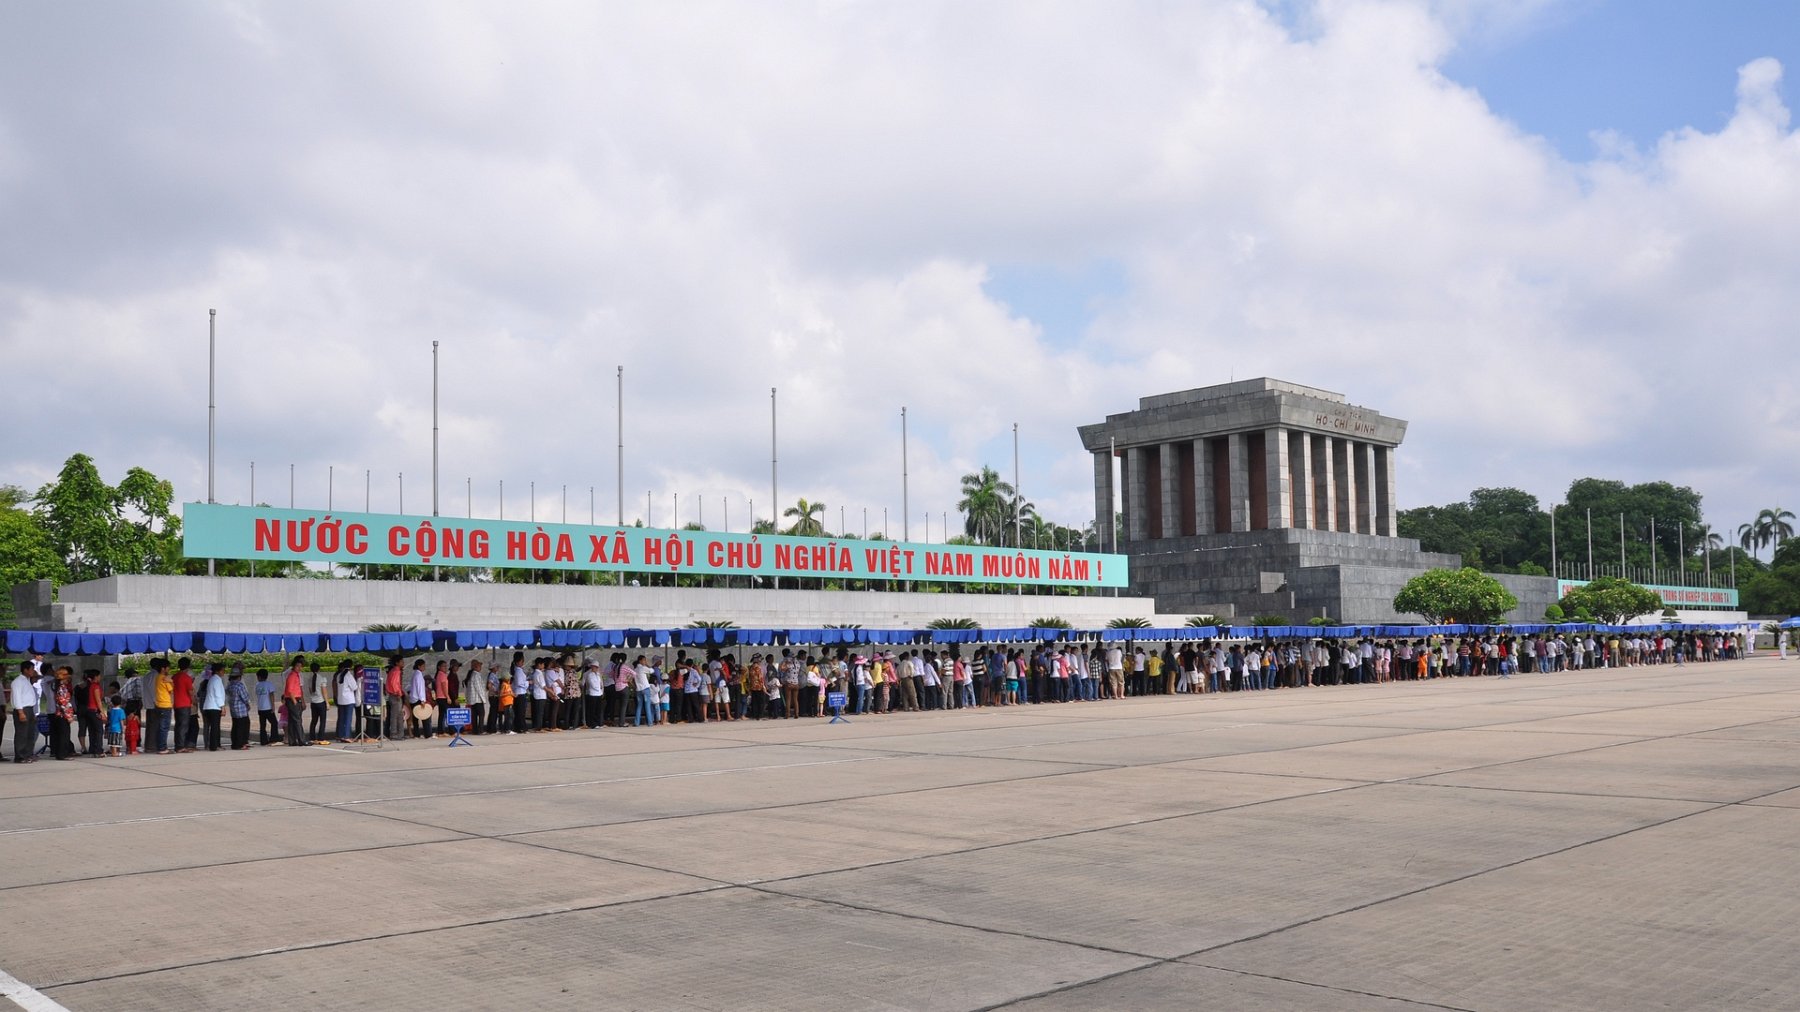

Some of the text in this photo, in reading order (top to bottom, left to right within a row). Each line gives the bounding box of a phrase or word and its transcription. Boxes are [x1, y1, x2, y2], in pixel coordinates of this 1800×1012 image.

[255, 516, 369, 555] NƯỚC
[388, 520, 490, 564] CỘNG
[507, 527, 575, 562] HÒA
[590, 531, 630, 564] XÃ
[644, 533, 694, 571] HỘI
[707, 536, 762, 569] CHỦ
[775, 543, 853, 572] NGHĨA
[865, 545, 915, 577] VIỆT
[925, 552, 974, 576] NAM
[982, 552, 1041, 579] MUÔN
[1048, 556, 1090, 580] NĂM
